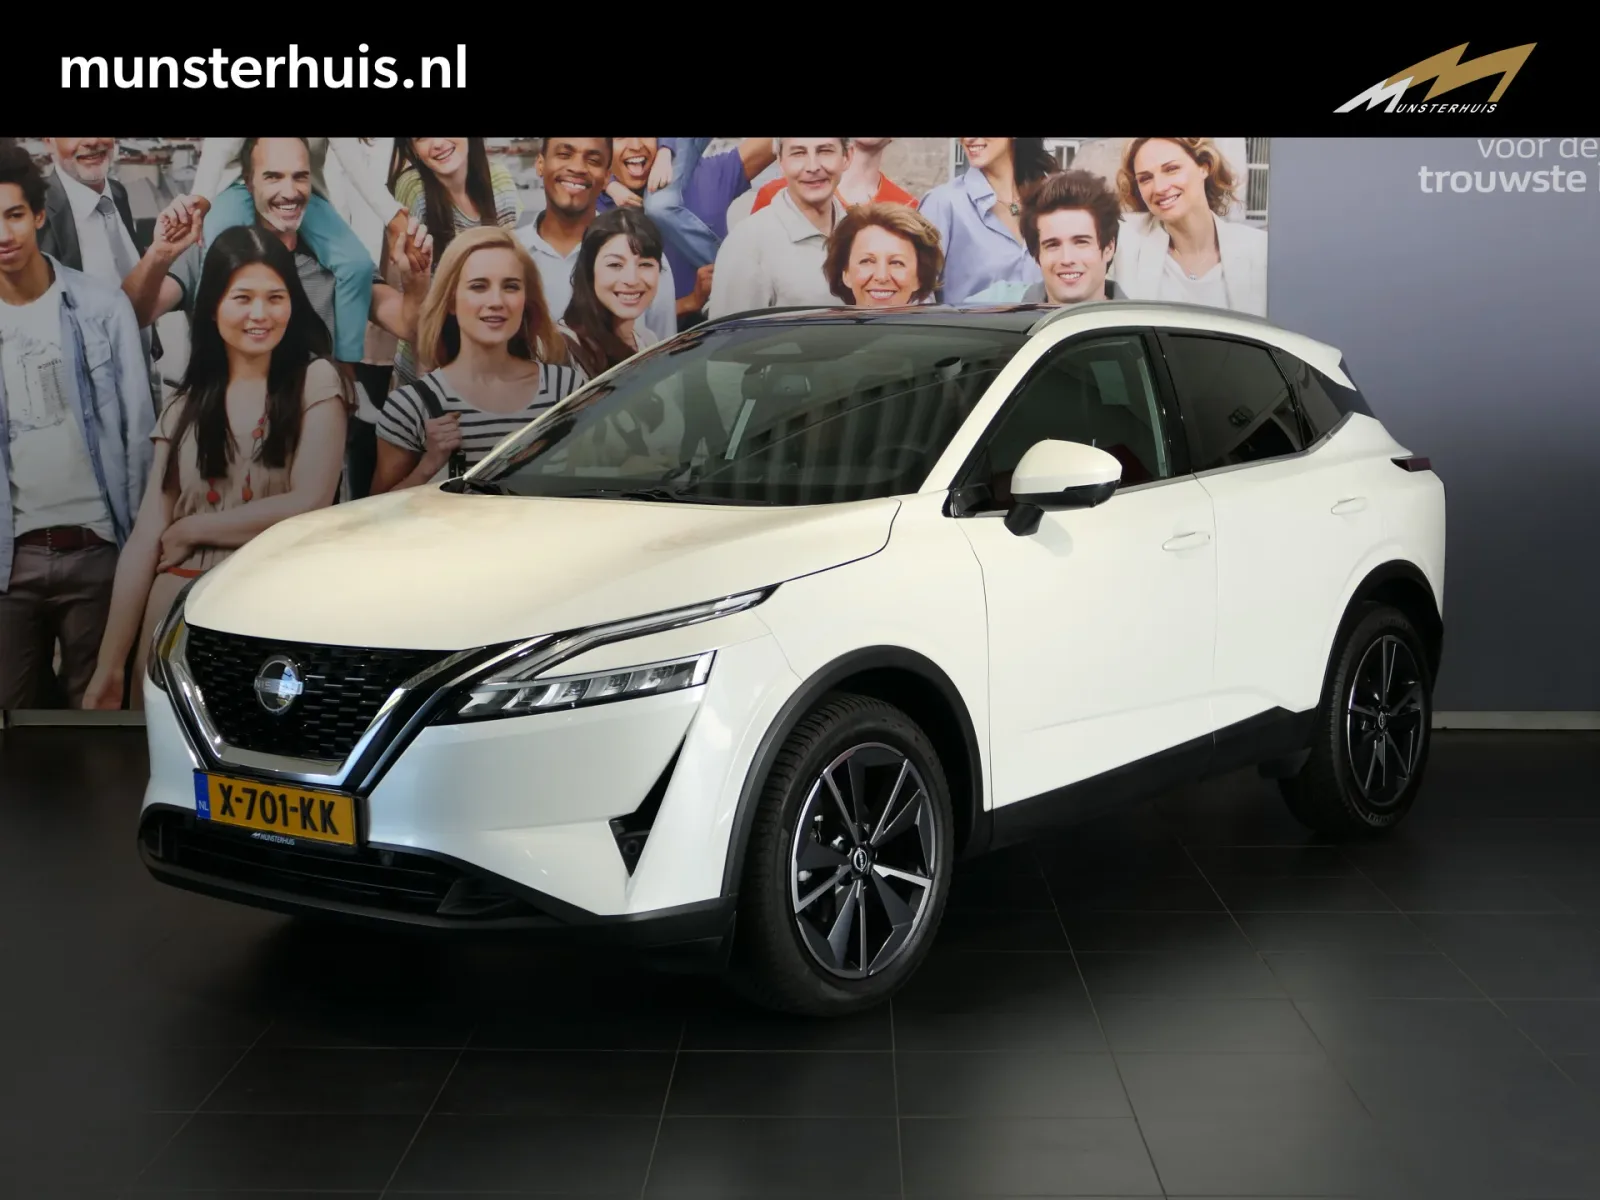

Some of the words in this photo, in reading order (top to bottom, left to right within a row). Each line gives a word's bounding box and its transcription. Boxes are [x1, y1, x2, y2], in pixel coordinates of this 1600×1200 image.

[1477, 138, 1551, 158] voor
[1559, 137, 1598, 158] de
[1418, 165, 1587, 193] trouwste
[198, 800, 210, 812] NL
[218, 782, 340, 836] X-701-KK
